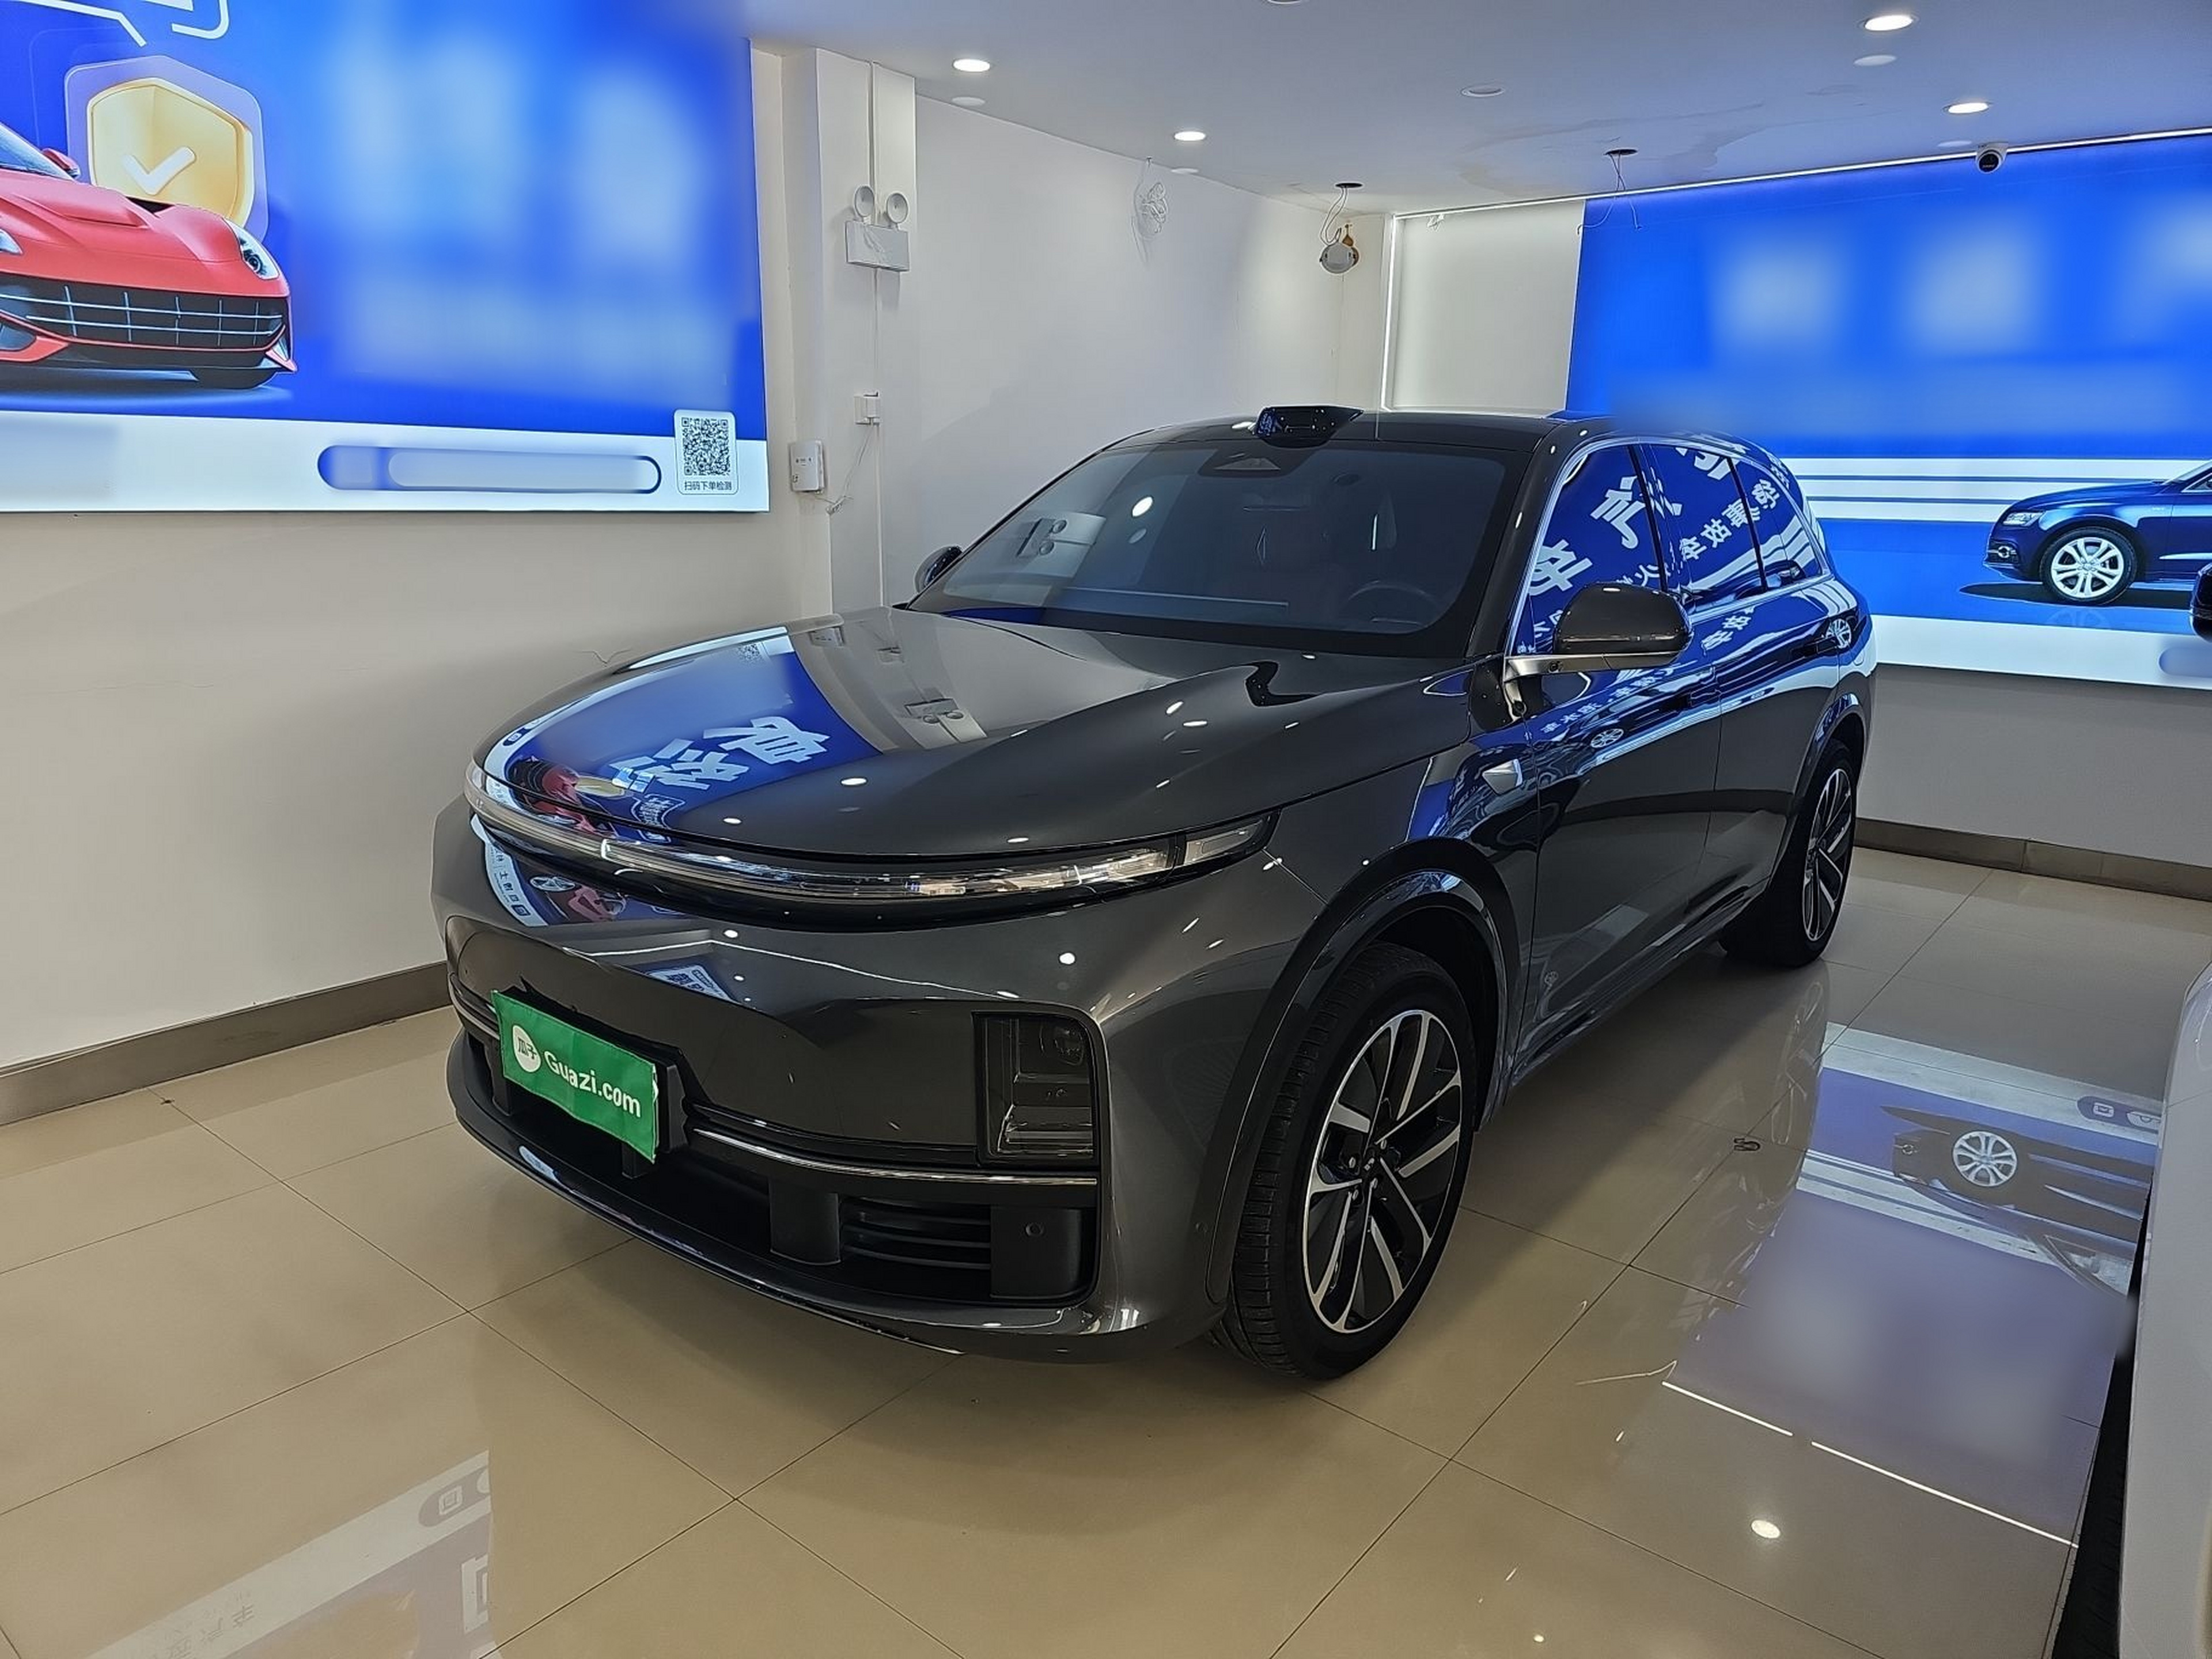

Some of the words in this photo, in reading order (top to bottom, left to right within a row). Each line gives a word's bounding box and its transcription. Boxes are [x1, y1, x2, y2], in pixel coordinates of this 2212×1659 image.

[684, 480, 732, 491] 扫码下单检测
[517, 1036, 537, 1060] 瓜子
[544, 1050, 641, 1118] Guazi.com
